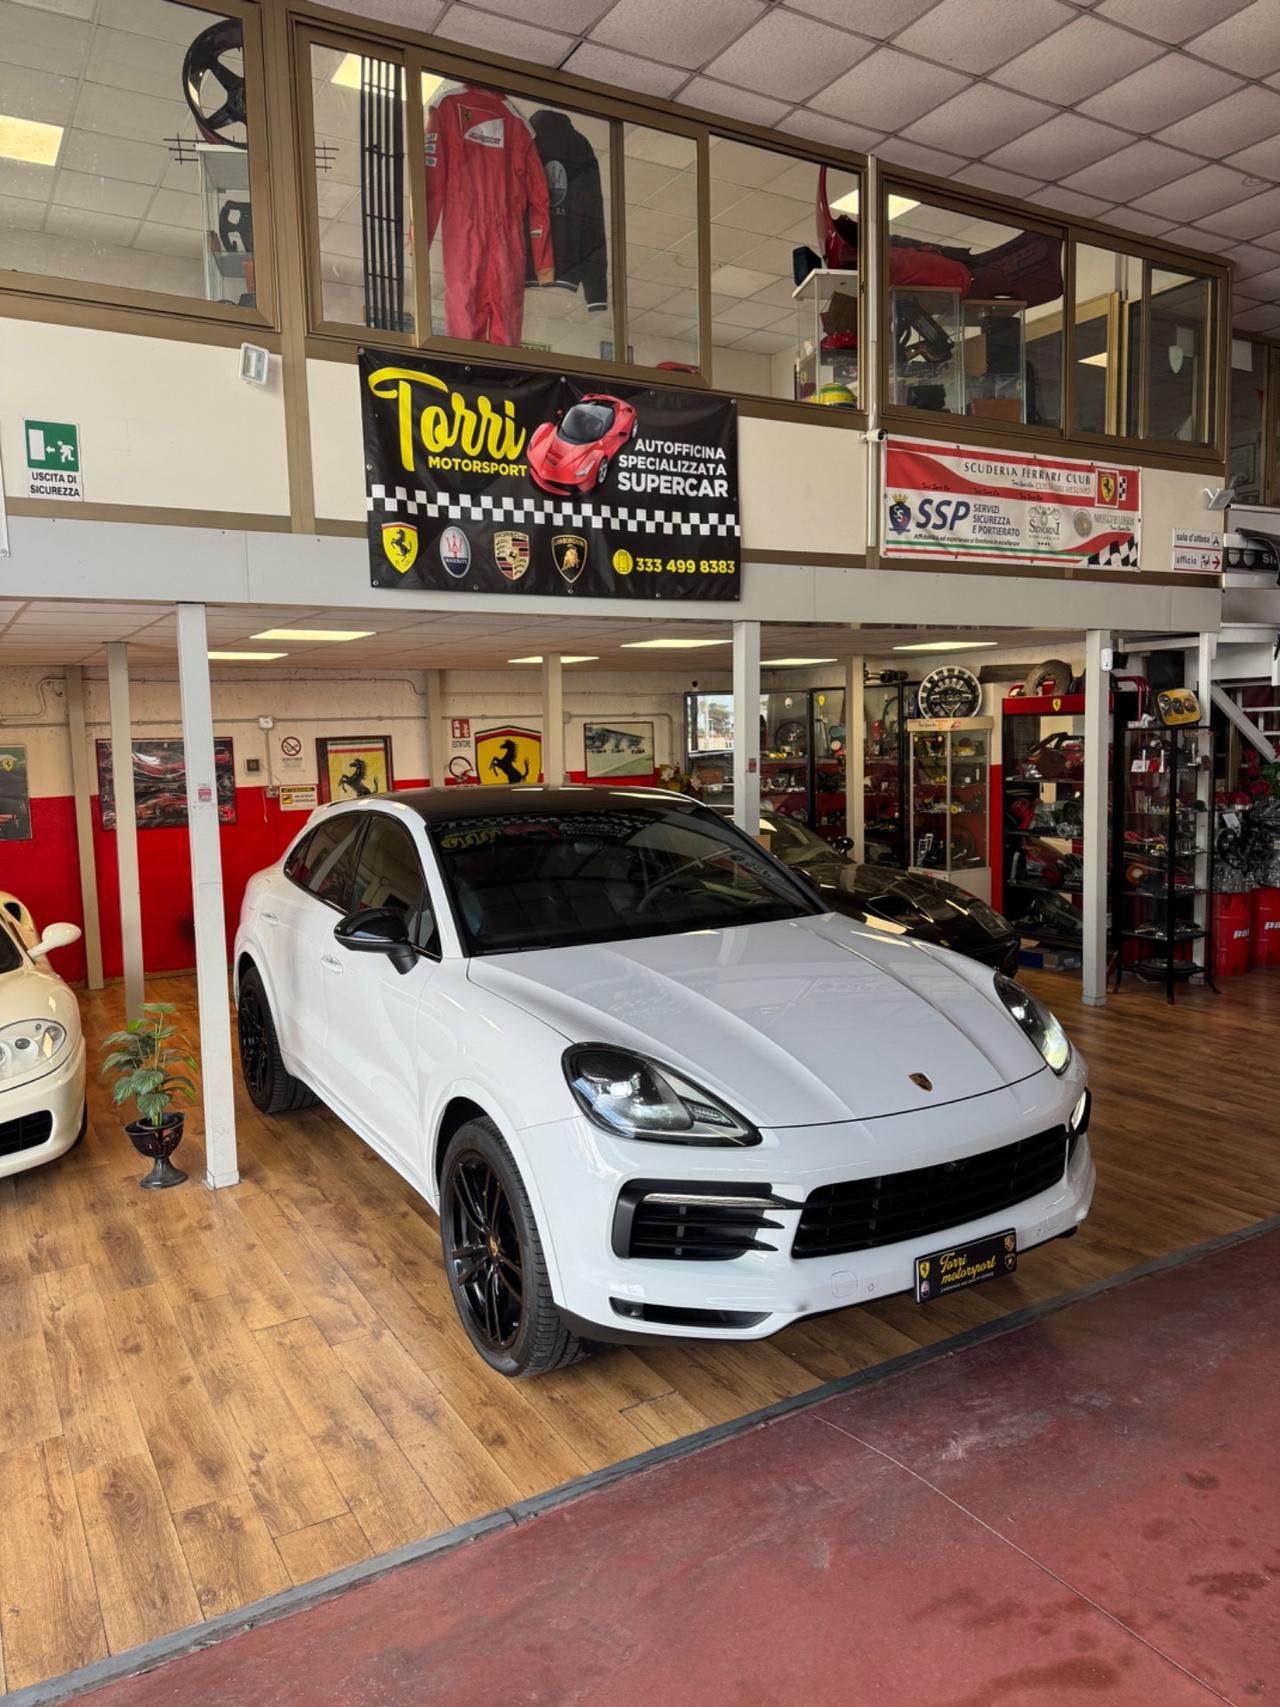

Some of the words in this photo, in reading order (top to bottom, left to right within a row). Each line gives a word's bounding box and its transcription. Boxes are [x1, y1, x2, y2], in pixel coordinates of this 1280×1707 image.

[368, 367, 527, 472] Torri
[635, 438, 727, 460] AUTOFFICINA
[428, 456, 528, 476] MOTORSPORT
[618, 454, 728, 476] SPECIALIZZATA
[964, 462, 1018, 477] SCUDERIA
[1022, 468, 1061, 482] FERRARI
[1066, 473, 1092, 485] CLUB
[32, 472, 65, 482] USCITA
[67, 474, 77, 484] DI
[617, 472, 729, 497] SUPERCAR
[30, 485, 80, 497] SICUREZZA
[916, 498, 971, 530] SSP
[973, 503, 1000, 514] SERVIZI
[973, 514, 1011, 525] SICUREZZA
[972, 525, 977, 534] E
[978, 525, 1020, 537] PORTIERATO
[1176, 533, 1188, 542] sala
[636, 557, 662, 572] 333
[666, 559, 696, 573] 499
[700, 560, 736, 574] 8383
[1176, 555, 1197, 565] ufficio
[940, 1252, 967, 1273] Torri
[941, 1255, 997, 1285] motorsport
